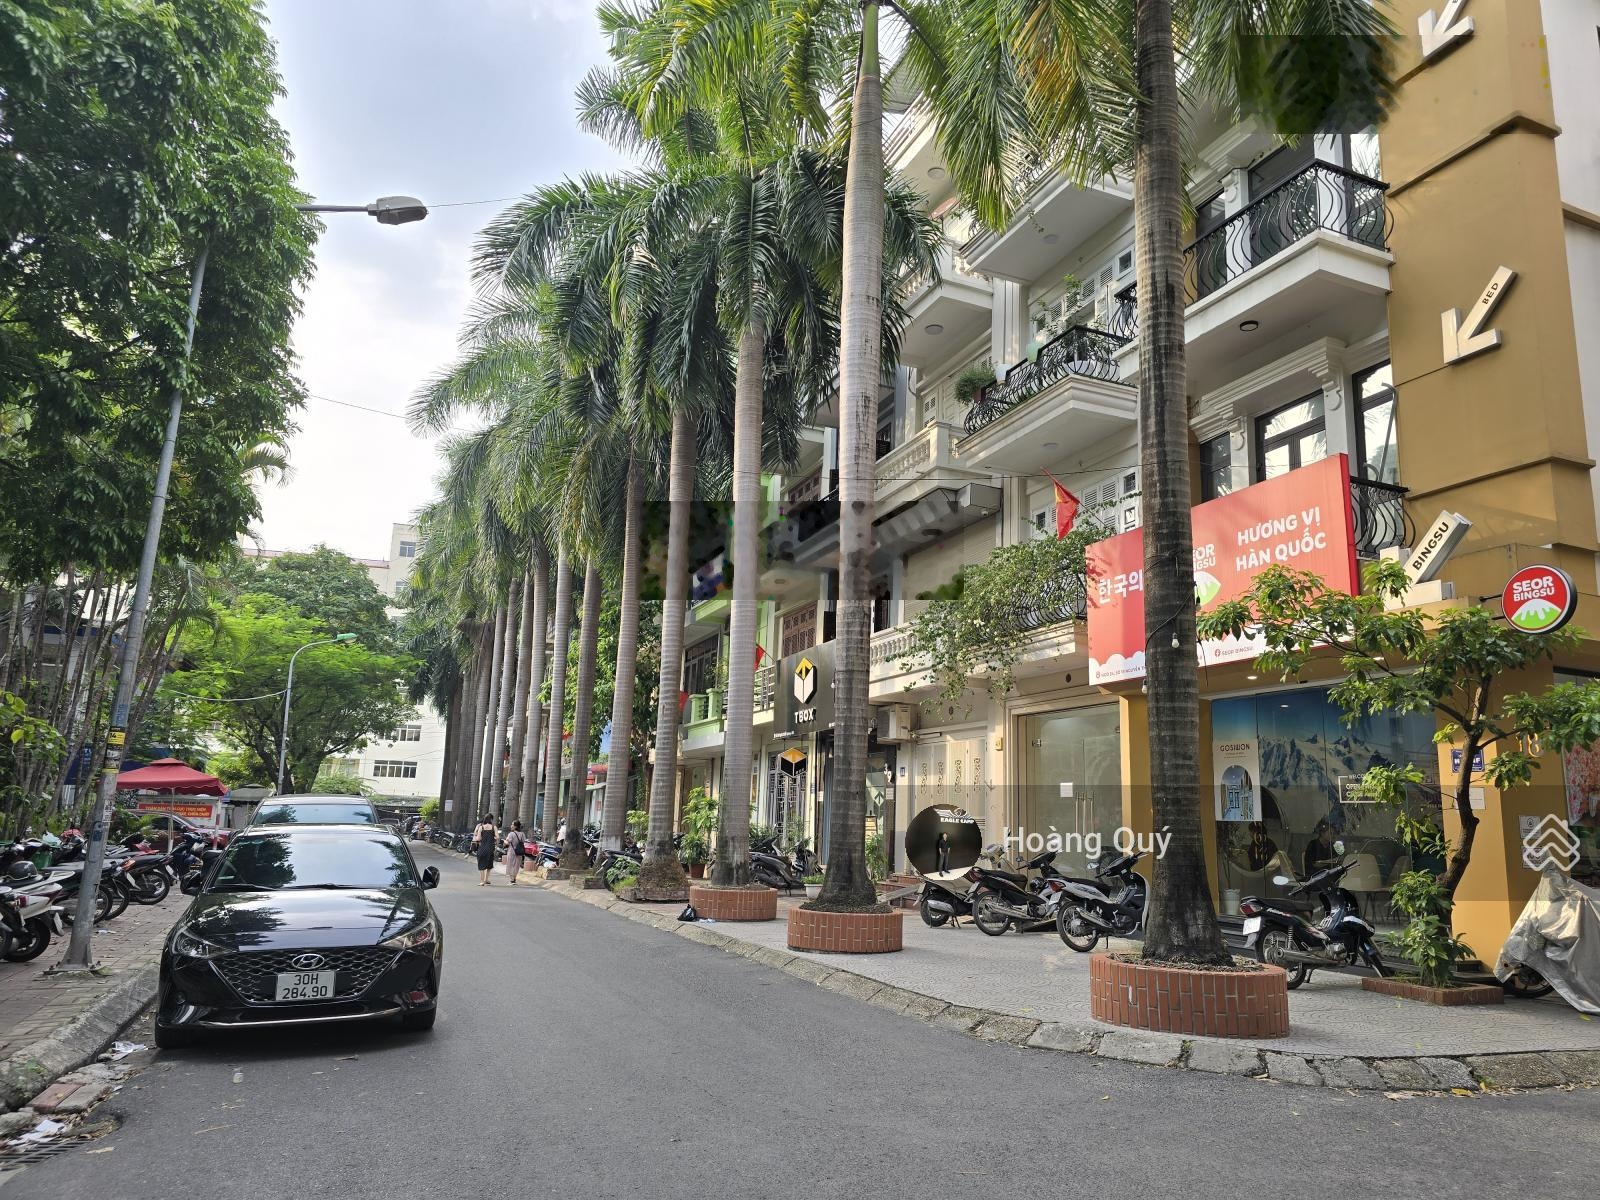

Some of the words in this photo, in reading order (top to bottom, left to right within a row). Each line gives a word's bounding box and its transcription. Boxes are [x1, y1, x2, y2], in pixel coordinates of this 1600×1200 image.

[1482, 283, 1498, 304] BED
[1237, 514, 1298, 546] HƯƠNG
[1301, 506, 1320, 527] VỊ
[1235, 548, 1271, 572] HÀN
[1274, 527, 1327, 562] QUỐC
[1412, 521, 1449, 571] BINGSU
[1097, 568, 1143, 605] 한국의
[1512, 575, 1554, 593] SEOR
[1513, 588, 1555, 602] BINGSU
[794, 707, 814, 723] TBOX
[293, 973, 319, 986] 30H
[282, 985, 328, 1000] 284.90
